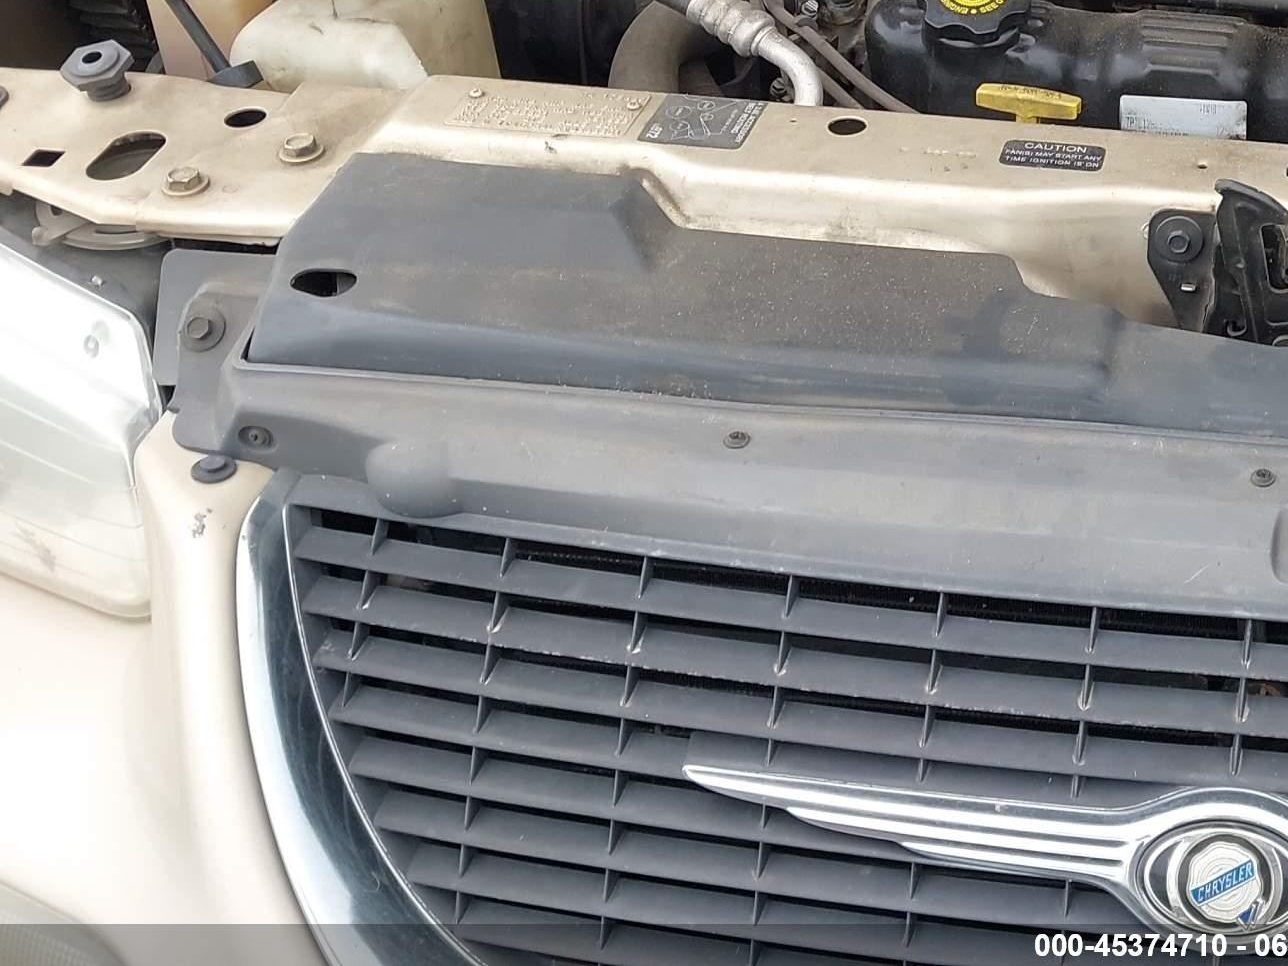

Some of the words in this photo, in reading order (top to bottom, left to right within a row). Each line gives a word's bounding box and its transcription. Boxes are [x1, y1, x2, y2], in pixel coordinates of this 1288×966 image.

[1024, 142, 1088, 153] CAUTION
[1055, 152, 1082, 160] START
[1029, 157, 1072, 165] IGNITION
[1196, 860, 1254, 903] CHRYSLER
